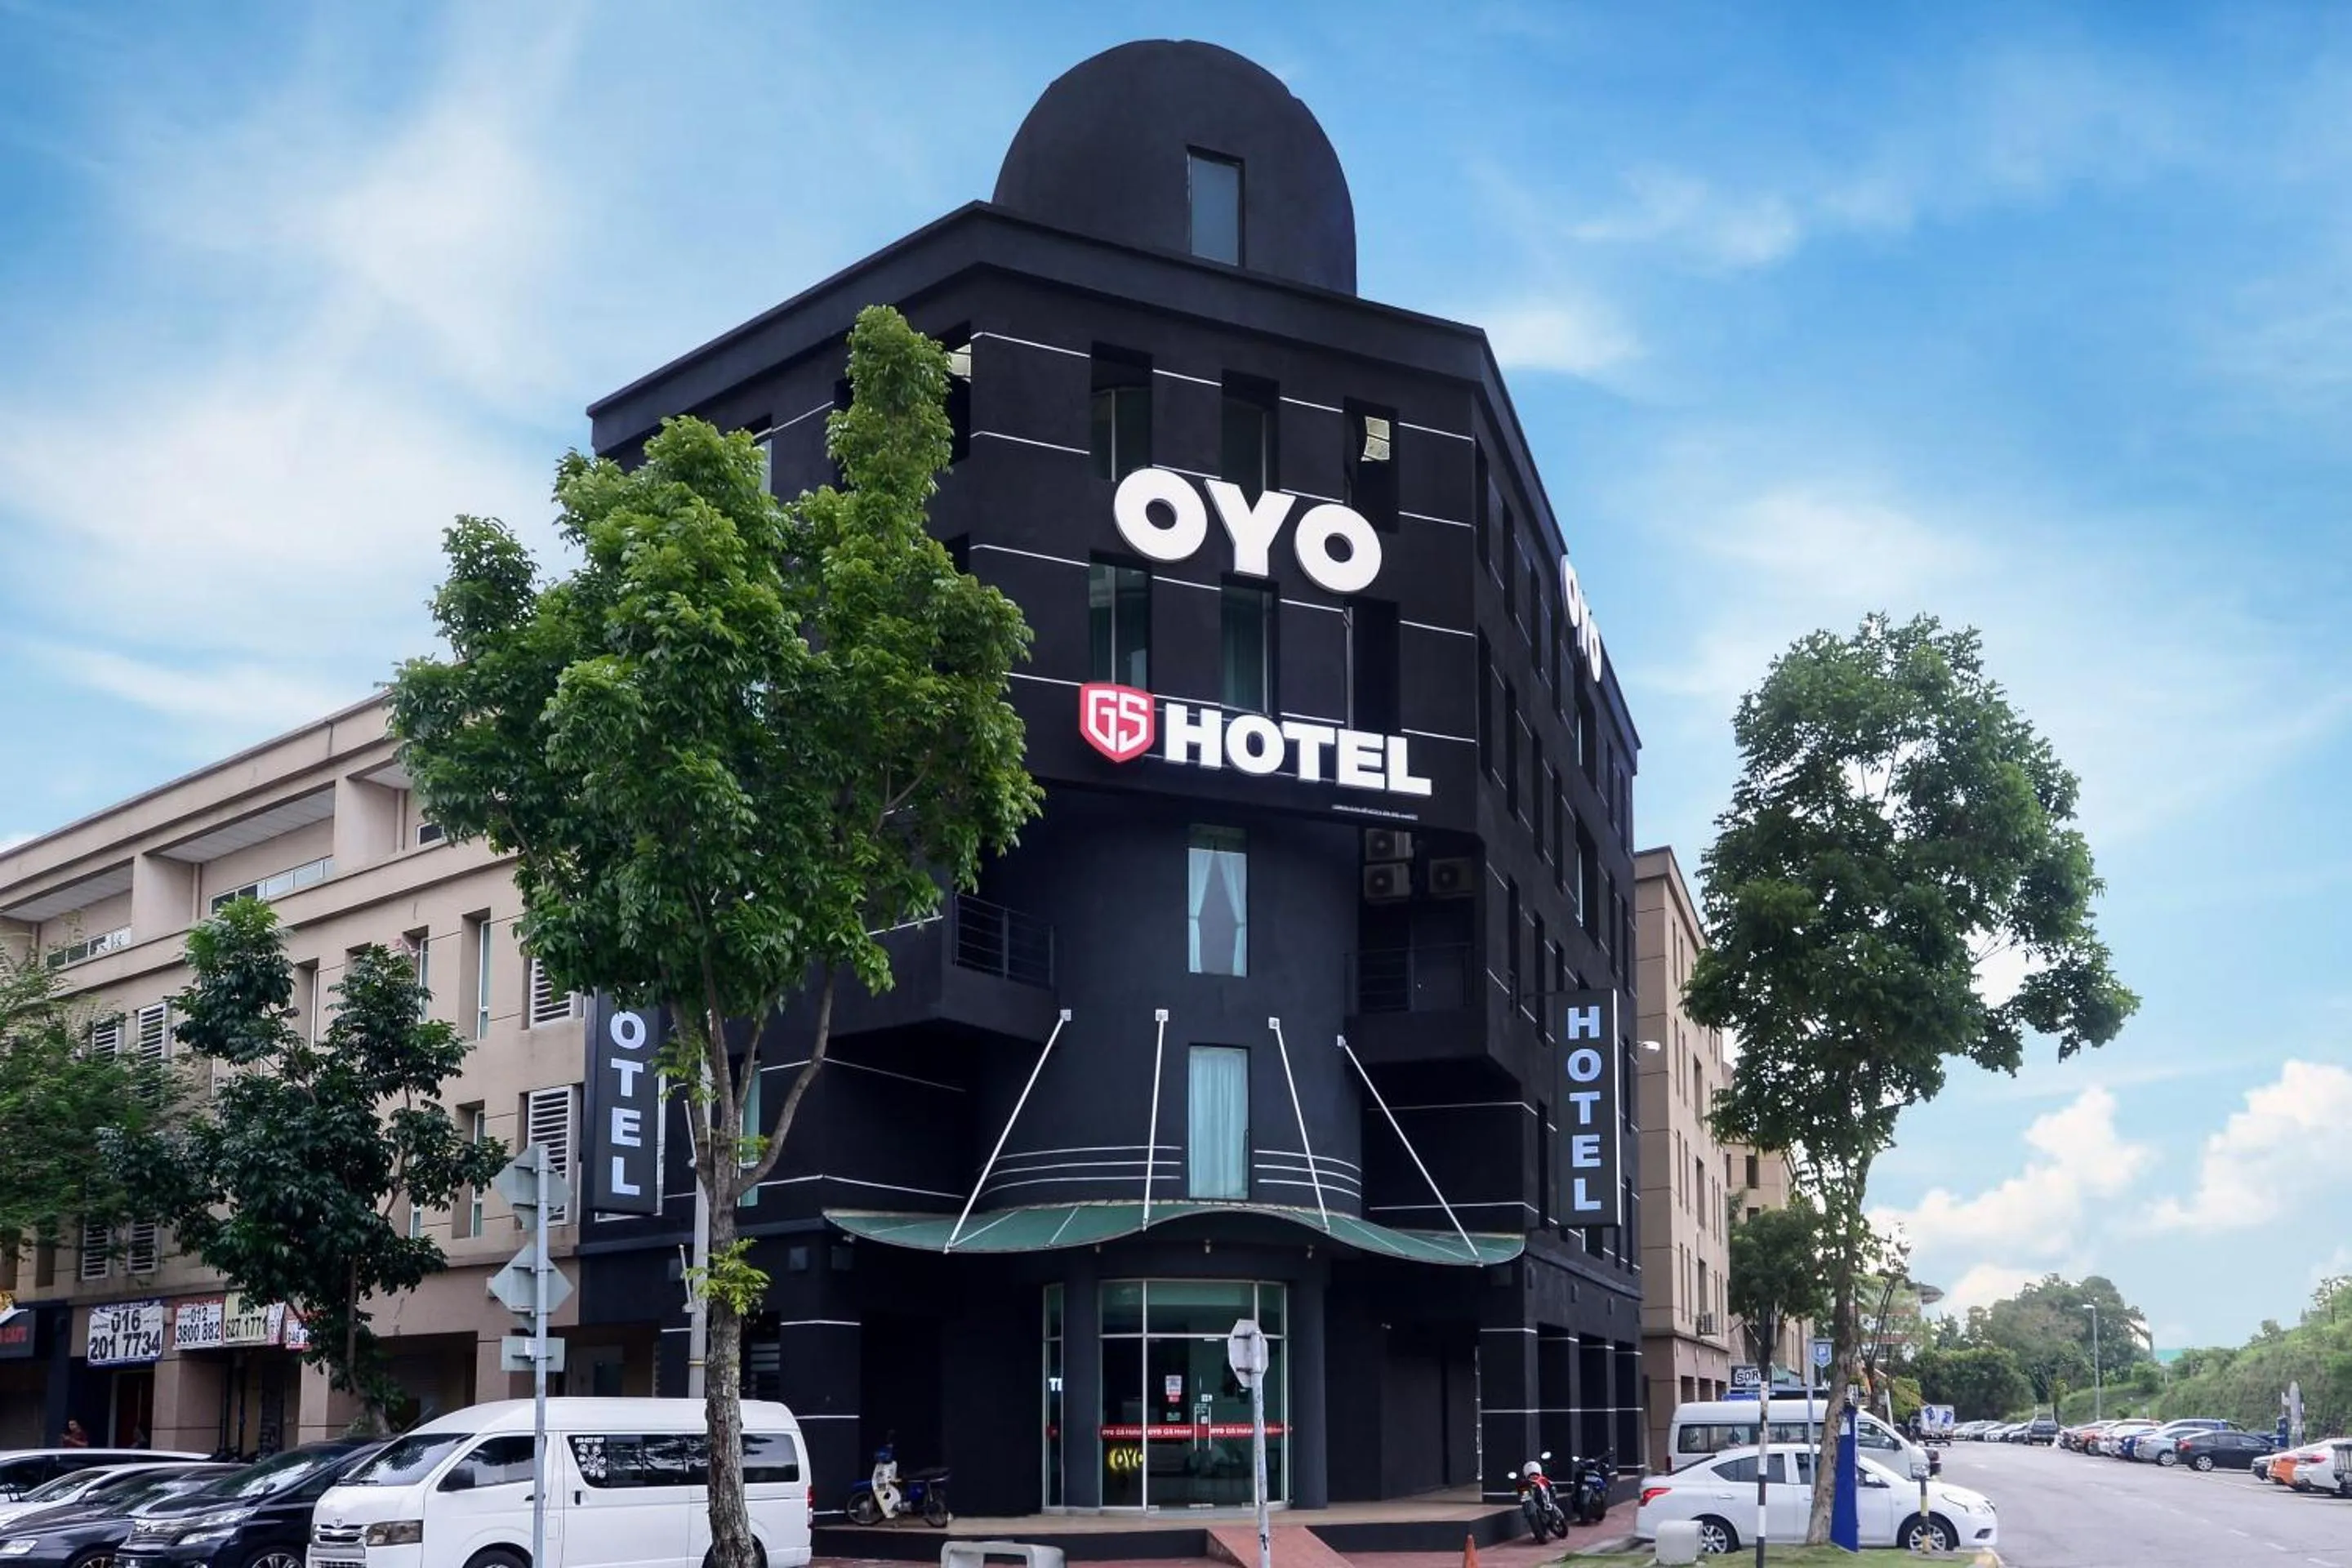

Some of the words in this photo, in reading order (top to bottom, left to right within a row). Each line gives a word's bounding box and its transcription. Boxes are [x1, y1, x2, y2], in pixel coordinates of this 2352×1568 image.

[1114, 467, 1382, 594] OYO
[1088, 689, 1147, 753] GS
[1165, 703, 1432, 797] HOTEL
[610, 1010, 647, 1196] OTEL
[1567, 1006, 1601, 1210] HOTEL
[90, 1335, 117, 1360] 201
[122, 1330, 161, 1356] 7734
[110, 1309, 141, 1333] 016
[190, 1307, 208, 1323] 012
